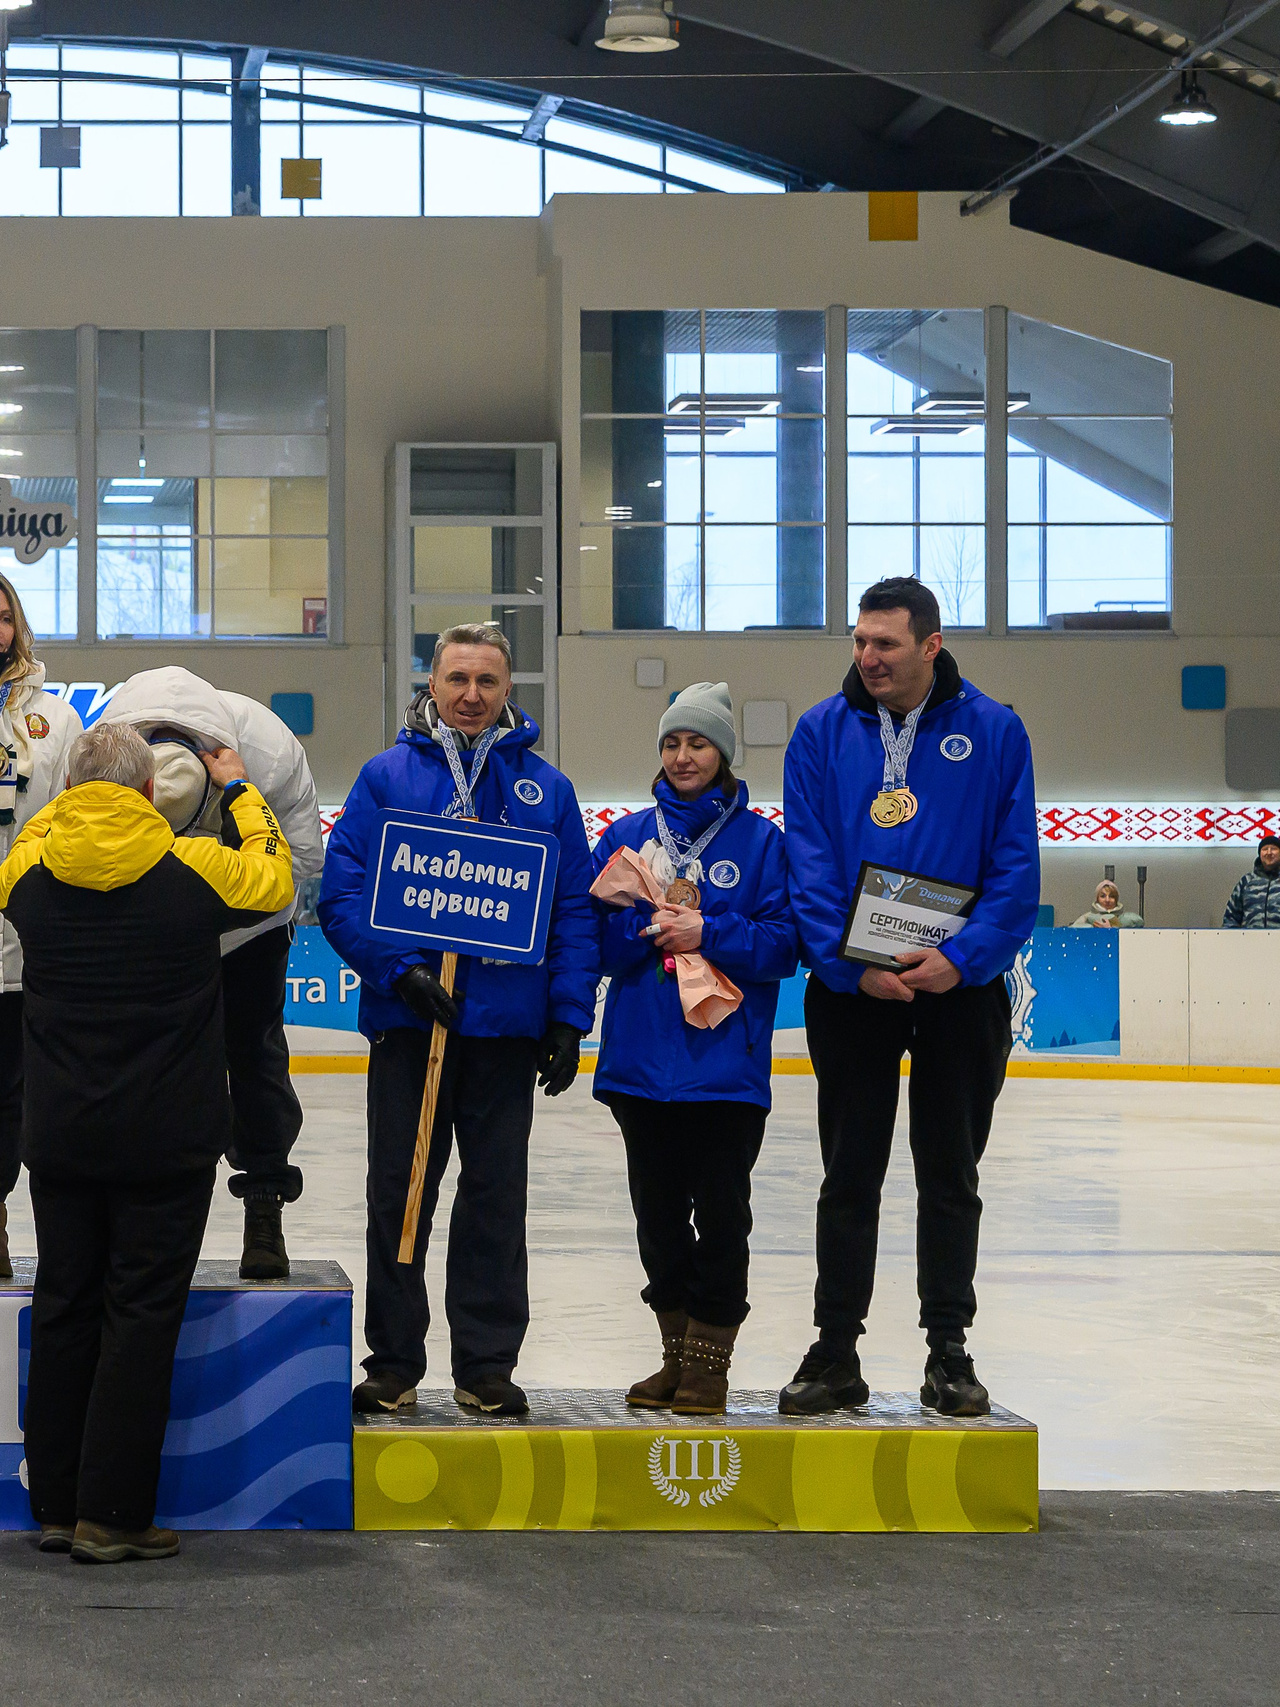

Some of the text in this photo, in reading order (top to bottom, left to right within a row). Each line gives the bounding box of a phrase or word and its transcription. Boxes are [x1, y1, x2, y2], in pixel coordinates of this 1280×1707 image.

[391, 842, 531, 891] Академия
[403, 886, 510, 922] сервиса
[869, 912, 949, 941] СЕРТИФИКАТ
[663, 1439, 726, 1480] III
